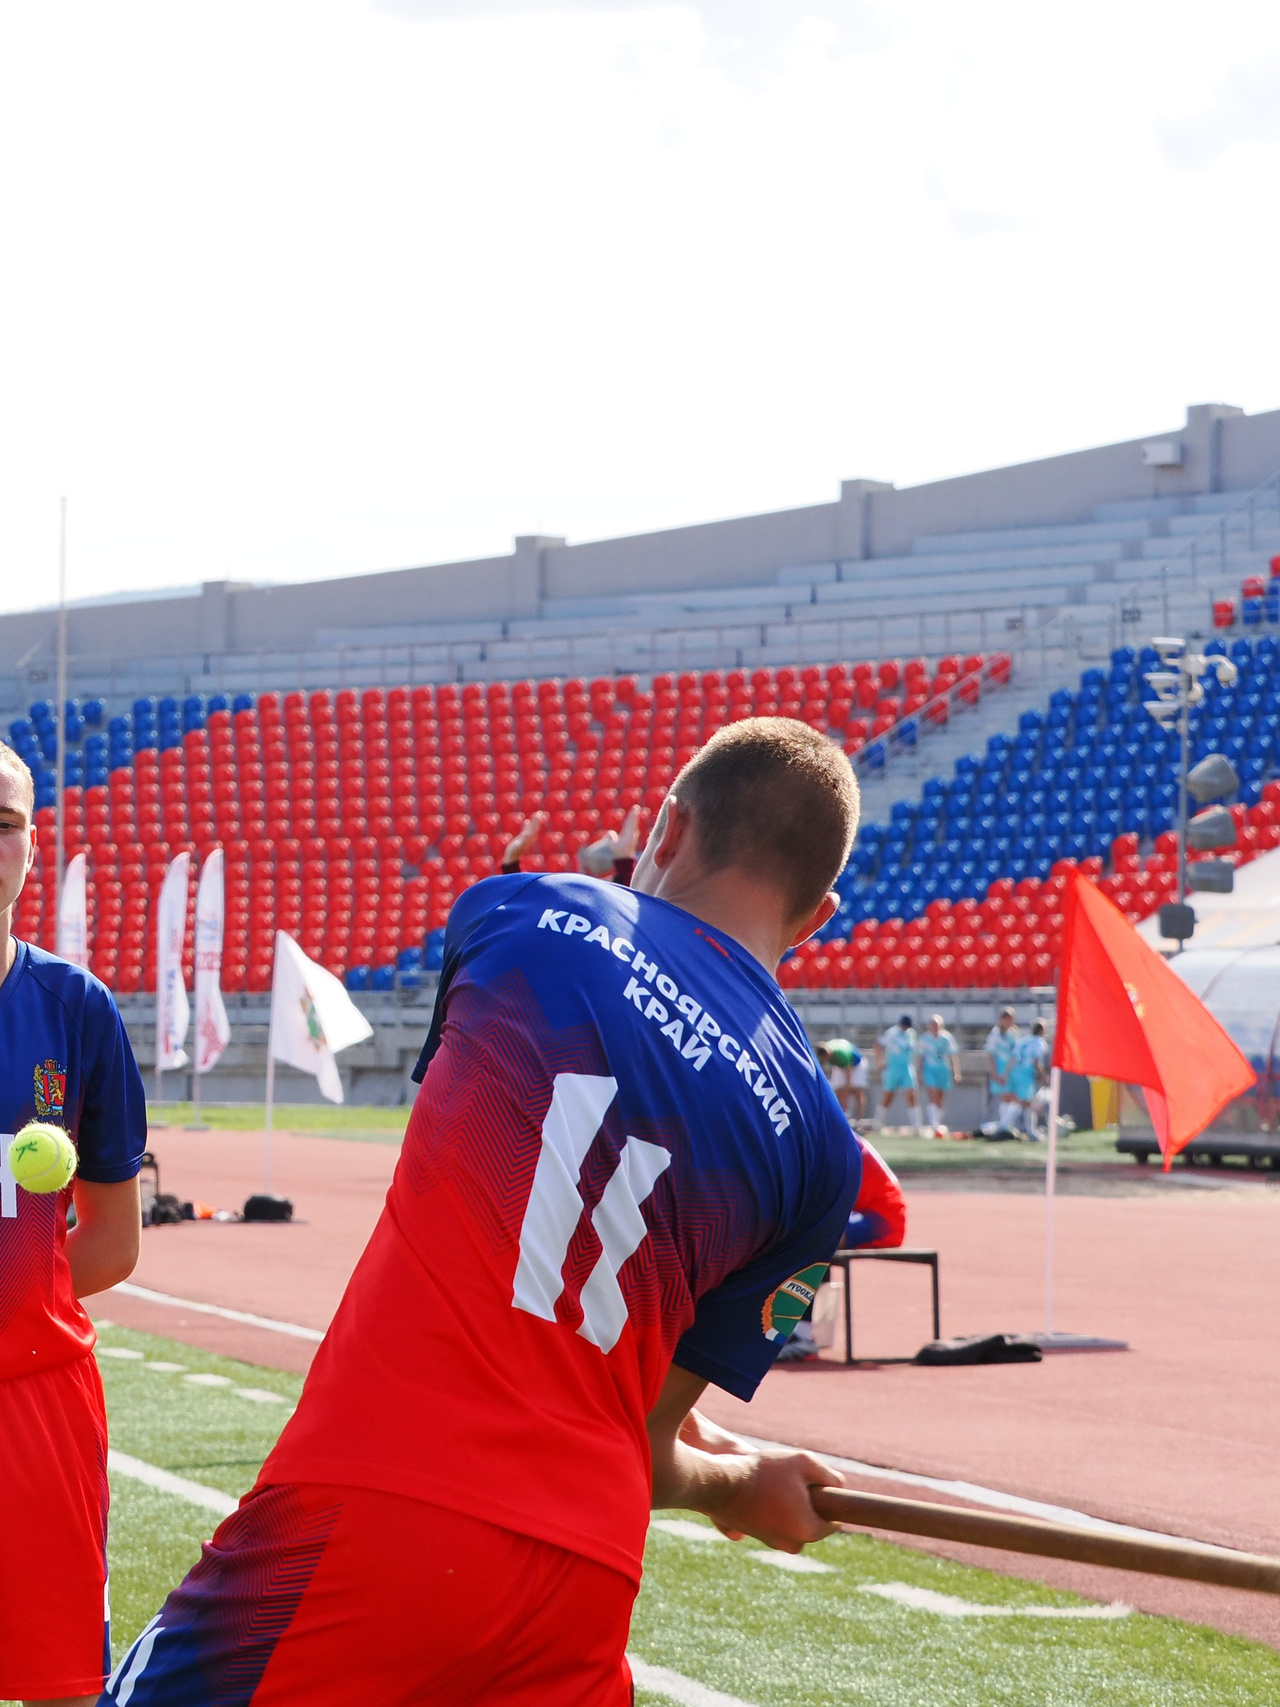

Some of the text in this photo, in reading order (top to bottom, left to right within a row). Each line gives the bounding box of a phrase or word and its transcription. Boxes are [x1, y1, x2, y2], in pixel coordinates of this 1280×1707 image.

[537, 908, 792, 1137] КРАСНОЯРСКИЙ
[623, 976, 713, 1072] КРАЙ
[511, 1072, 672, 1355] 11
